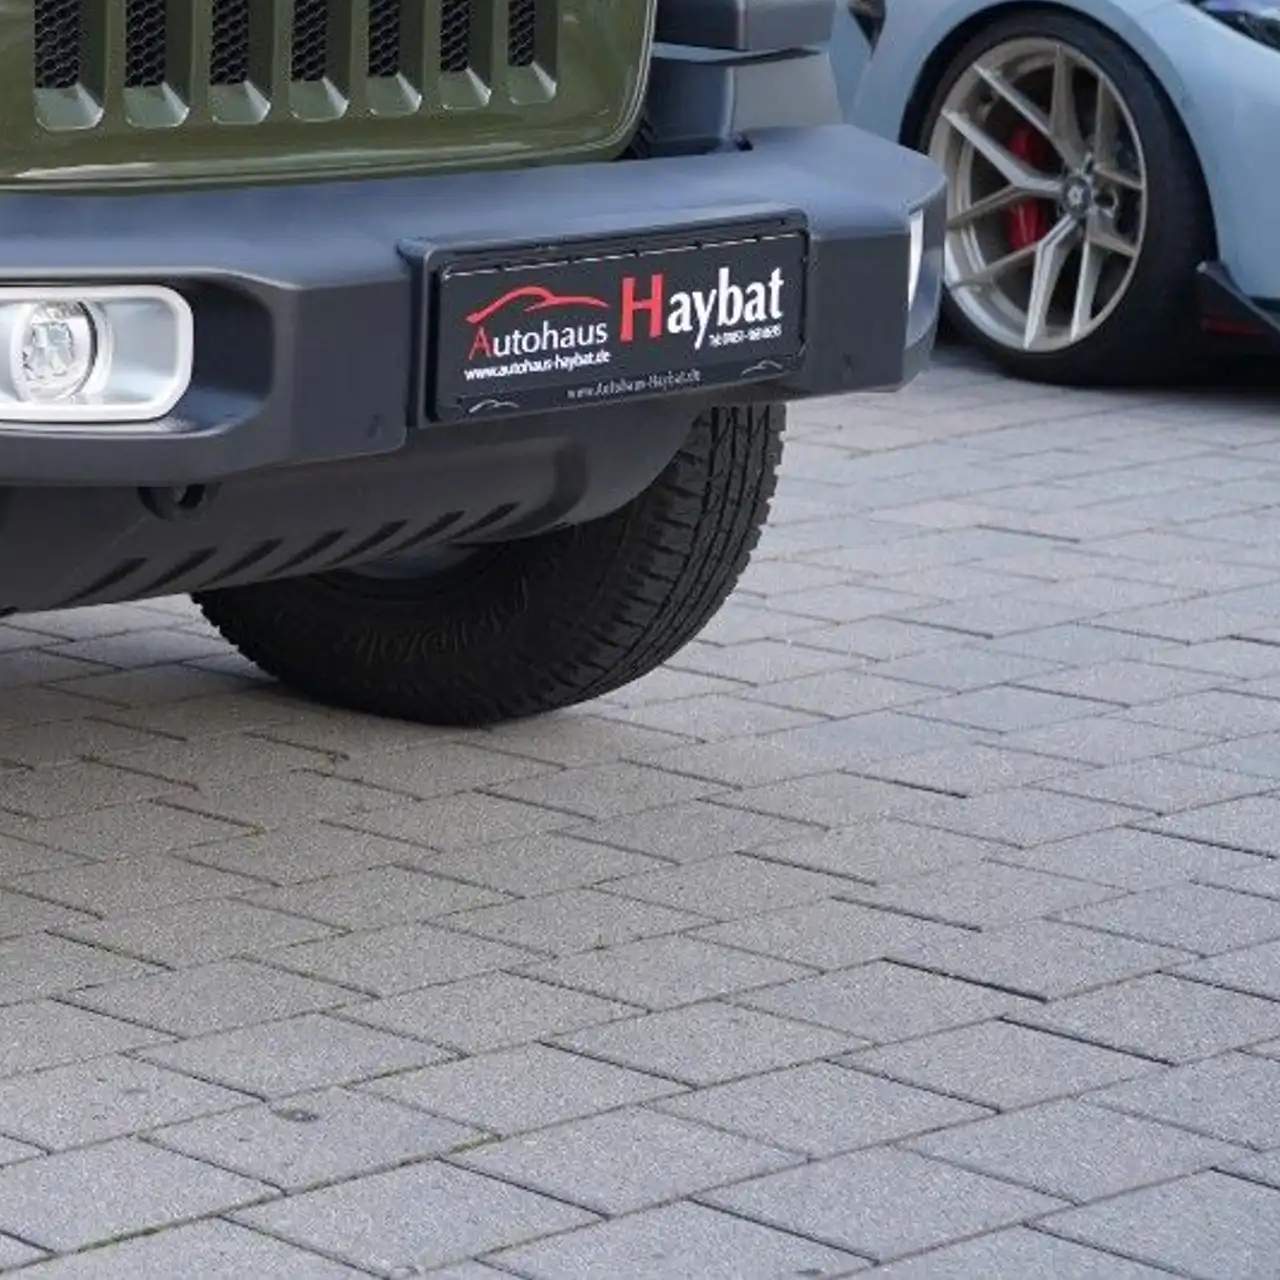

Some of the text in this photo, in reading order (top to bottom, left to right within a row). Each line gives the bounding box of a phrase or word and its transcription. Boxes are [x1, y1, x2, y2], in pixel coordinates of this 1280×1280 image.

[468, 267, 785, 361] Autohaus Haybat
[464, 348, 611, 382] www.autohaus-haybat.de
